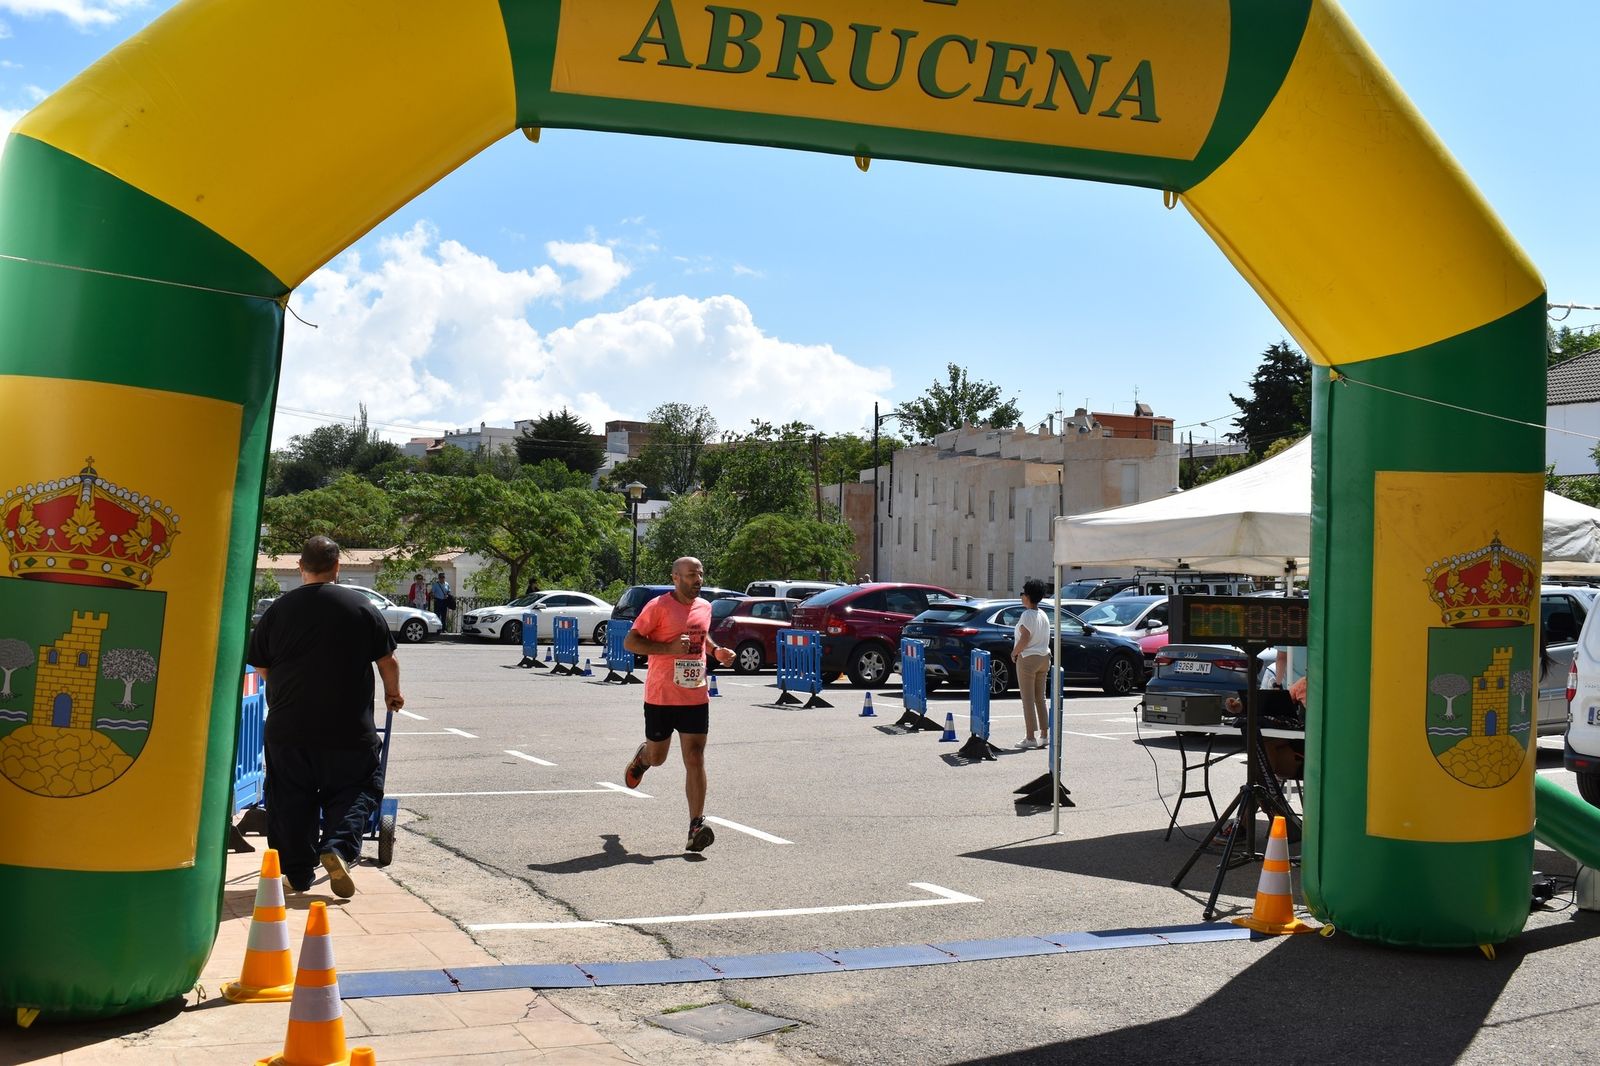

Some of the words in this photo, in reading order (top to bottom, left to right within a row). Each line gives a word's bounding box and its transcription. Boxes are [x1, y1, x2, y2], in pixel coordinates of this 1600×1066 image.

[618, 0, 1162, 123] ABRUCENA
[1178, 662, 1194, 671] 9268
[1196, 663, 1210, 672] JNT
[683, 668, 701, 678] 583
